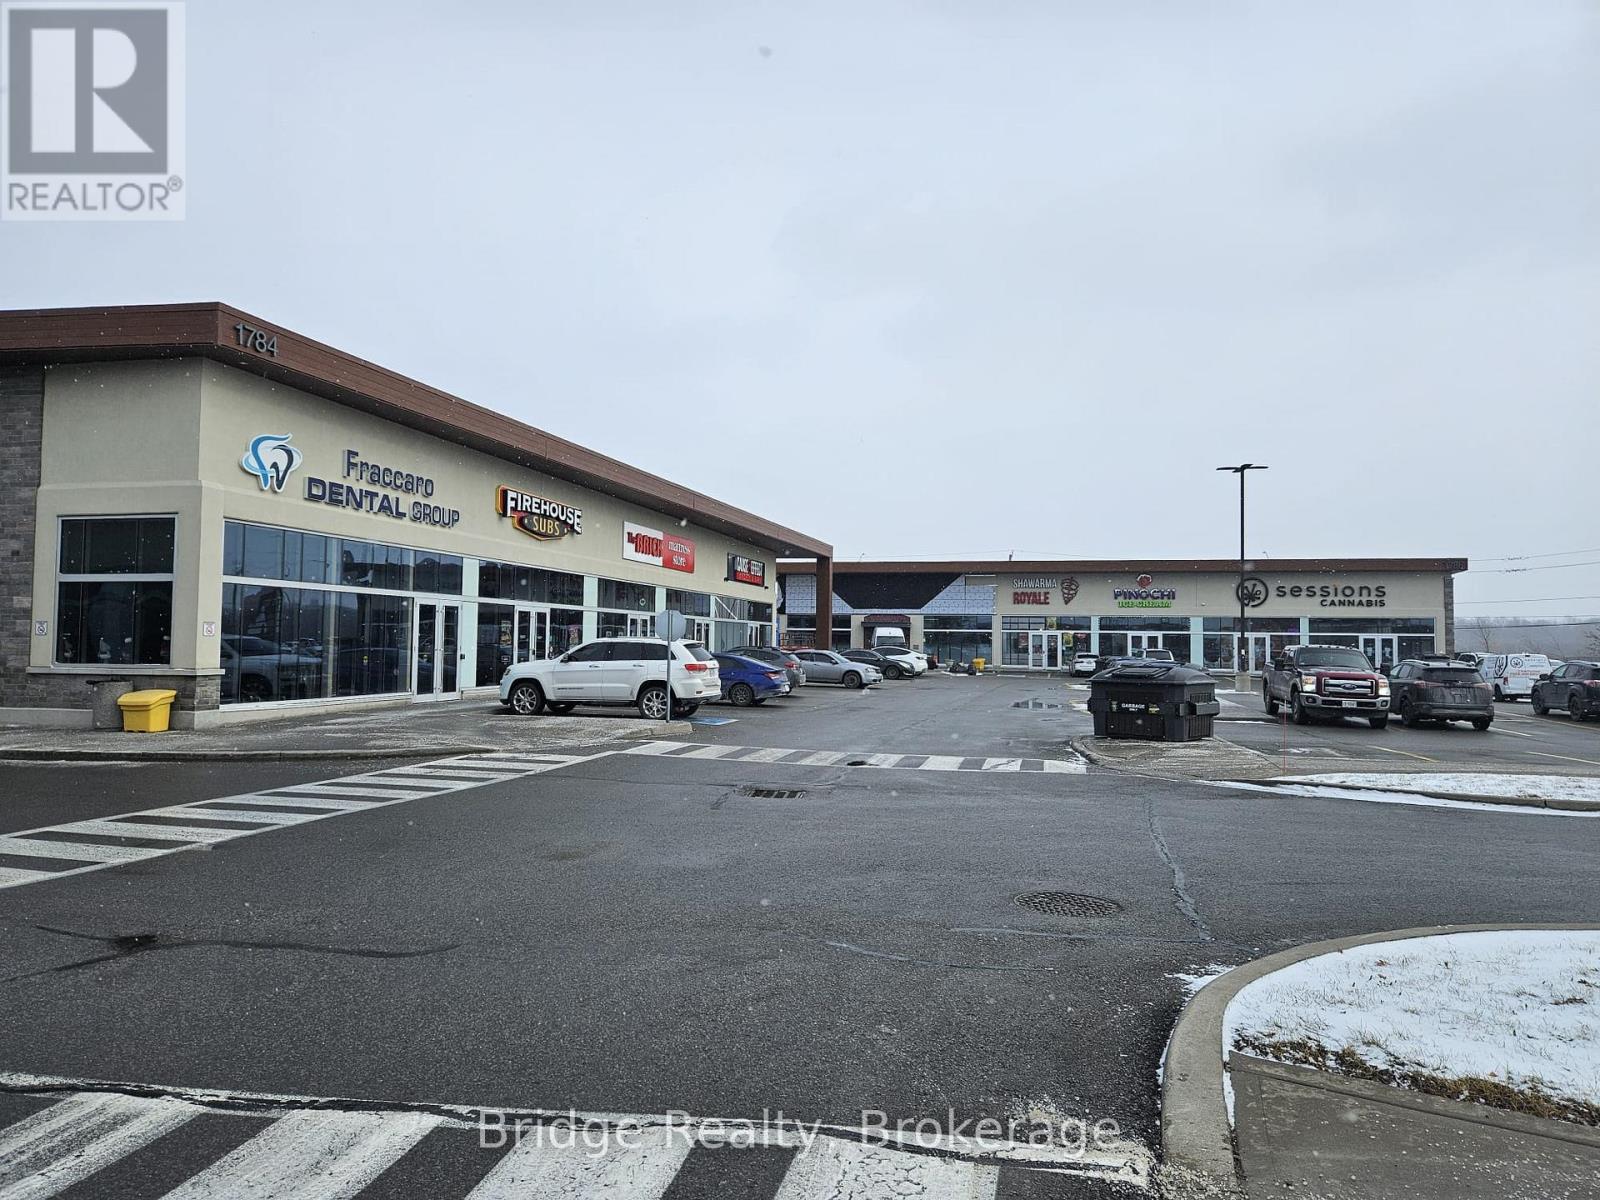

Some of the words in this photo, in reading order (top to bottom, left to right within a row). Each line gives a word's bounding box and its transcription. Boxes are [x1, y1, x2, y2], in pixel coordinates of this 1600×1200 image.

[235, 323, 279, 357] 1784
[343, 449, 434, 498] Fraccaro
[304, 476, 407, 519] DENTAL
[410, 501, 460, 528] GROUP
[506, 490, 582, 534] FIREHOUSE
[532, 516, 560, 536] SUBS
[635, 533, 665, 558] BRICK
[1013, 578, 1057, 589] SHAWARMA
[1276, 583, 1386, 598] sessions
[1013, 591, 1050, 605] ROYALE
[1113, 588, 1176, 600] PINOCHI
[1320, 599, 1386, 607] CANNABIS
